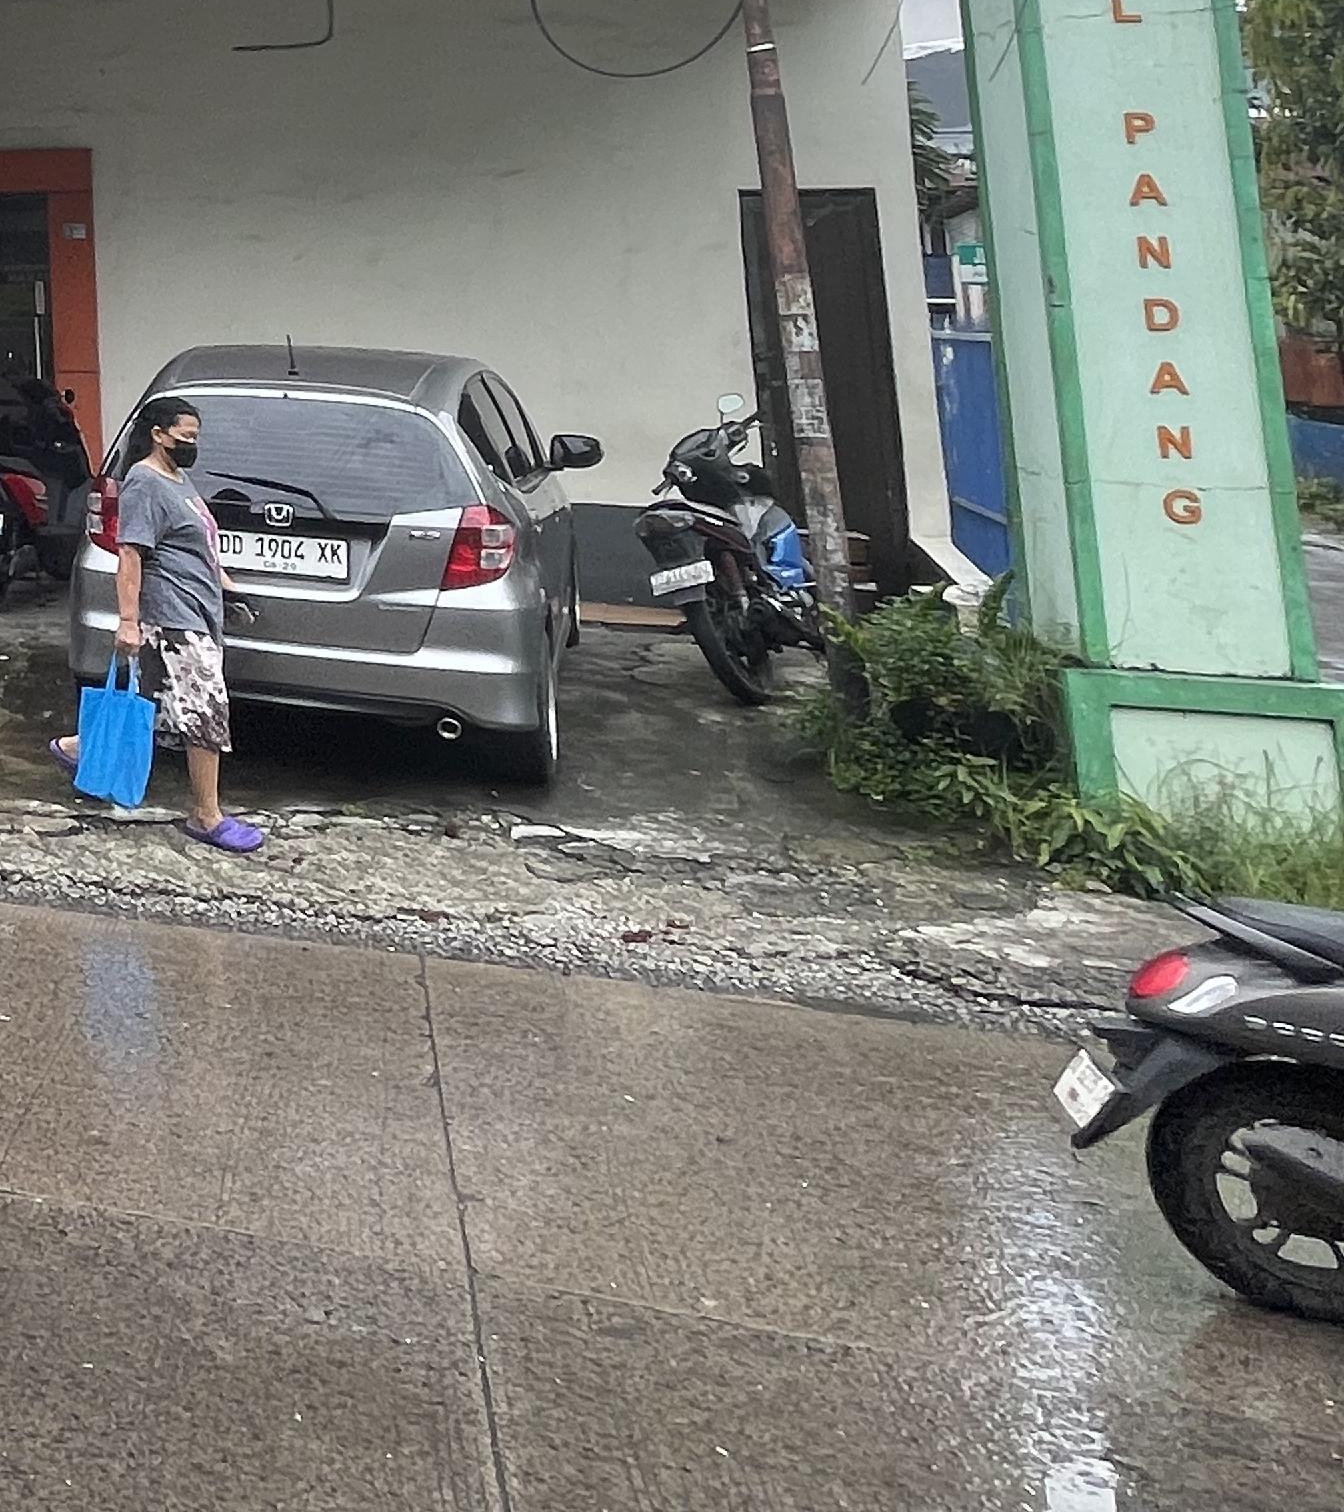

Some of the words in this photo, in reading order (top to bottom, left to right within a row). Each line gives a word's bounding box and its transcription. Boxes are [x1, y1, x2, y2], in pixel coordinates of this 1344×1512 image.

[1123, 112, 1203, 525] PANDANG
[219, 534, 243, 554] DD
[254, 537, 305, 560] 1904
[317, 542, 343, 565] XK
